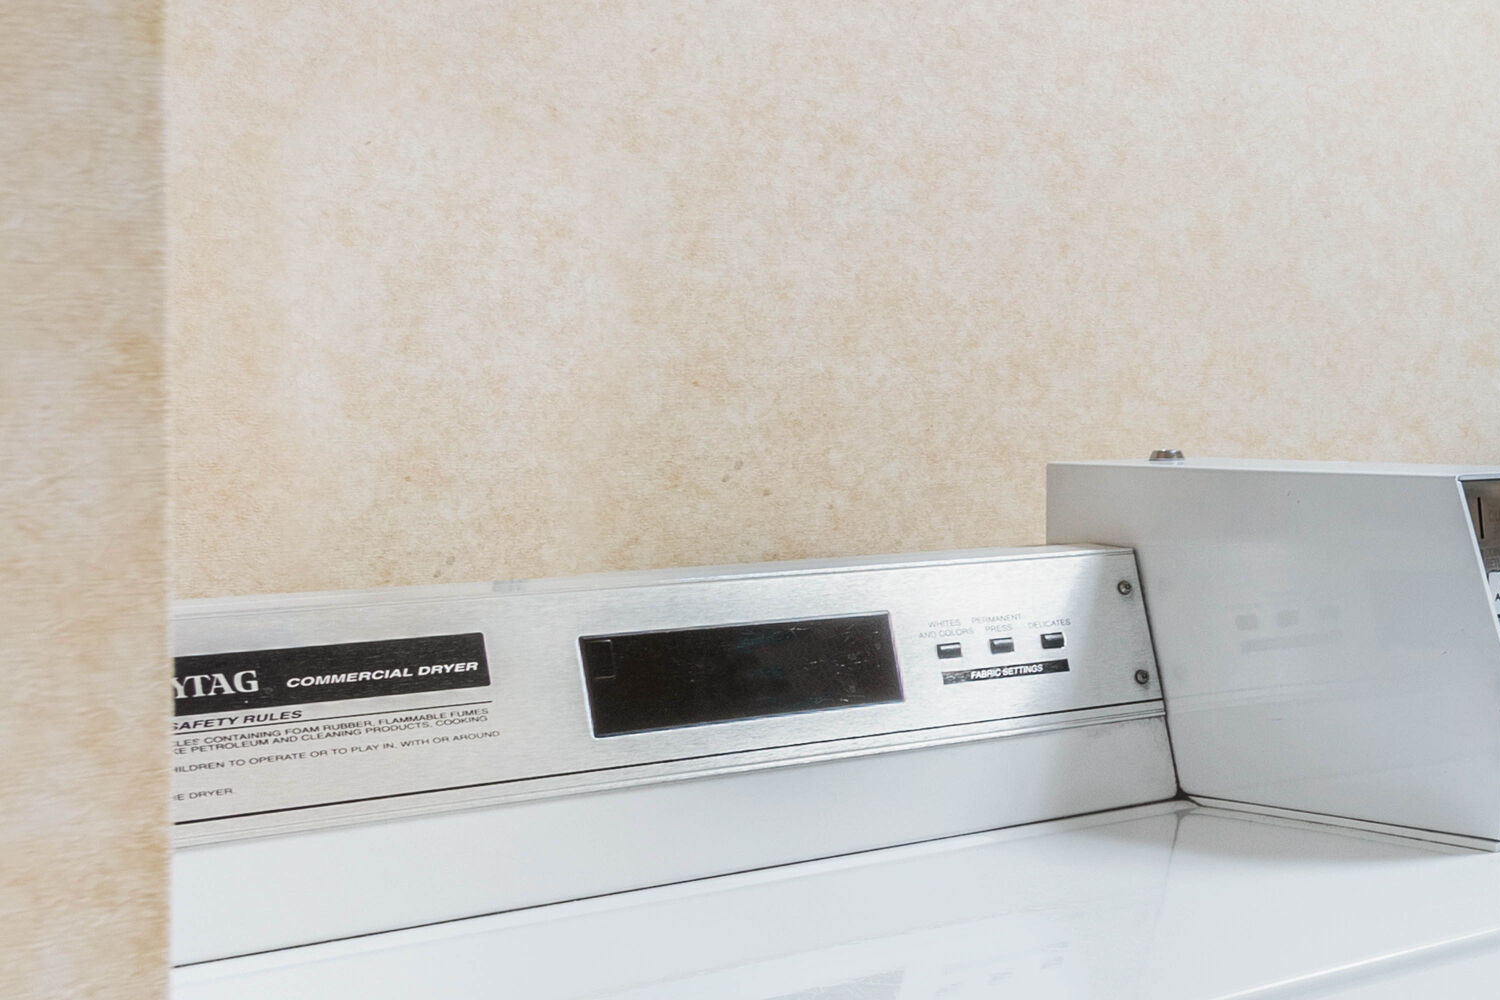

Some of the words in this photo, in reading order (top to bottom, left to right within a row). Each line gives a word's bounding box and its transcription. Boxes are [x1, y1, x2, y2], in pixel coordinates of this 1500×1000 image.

[928, 618, 961, 629] WHITES
[985, 624, 1013, 633] PRESS
[1027, 617, 1072, 630] DELICATES
[173, 670, 259, 699] YTAG
[286, 668, 414, 689] COMMERCIAL
[417, 662, 480, 677] DRYER
[971, 669, 1002, 681] FABRIC
[1002, 664, 1043, 677] SETTINGS
[243, 710, 304, 725] RULES
[174, 738, 200, 748] LES
[204, 730, 281, 745] CONTAINING
[285, 725, 320, 737] FOAM
[378, 712, 447, 726] FLAMMABLE
[450, 708, 488, 719] FUMES
[191, 739, 269, 754] PETROLEUM
[272, 735, 298, 745] AND
[301, 730, 362, 742] CLEANING
[435, 715, 488, 728] COOKING
[229, 759, 246, 768] TO
[249, 752, 306, 766] OPERATE
[310, 750, 328, 759] OR
[331, 747, 348, 756] TO
[351, 744, 379, 754] PLAY
[400, 739, 430, 749] WITH
[433, 736, 450, 745] OR
[453, 730, 501, 743] AROUND
